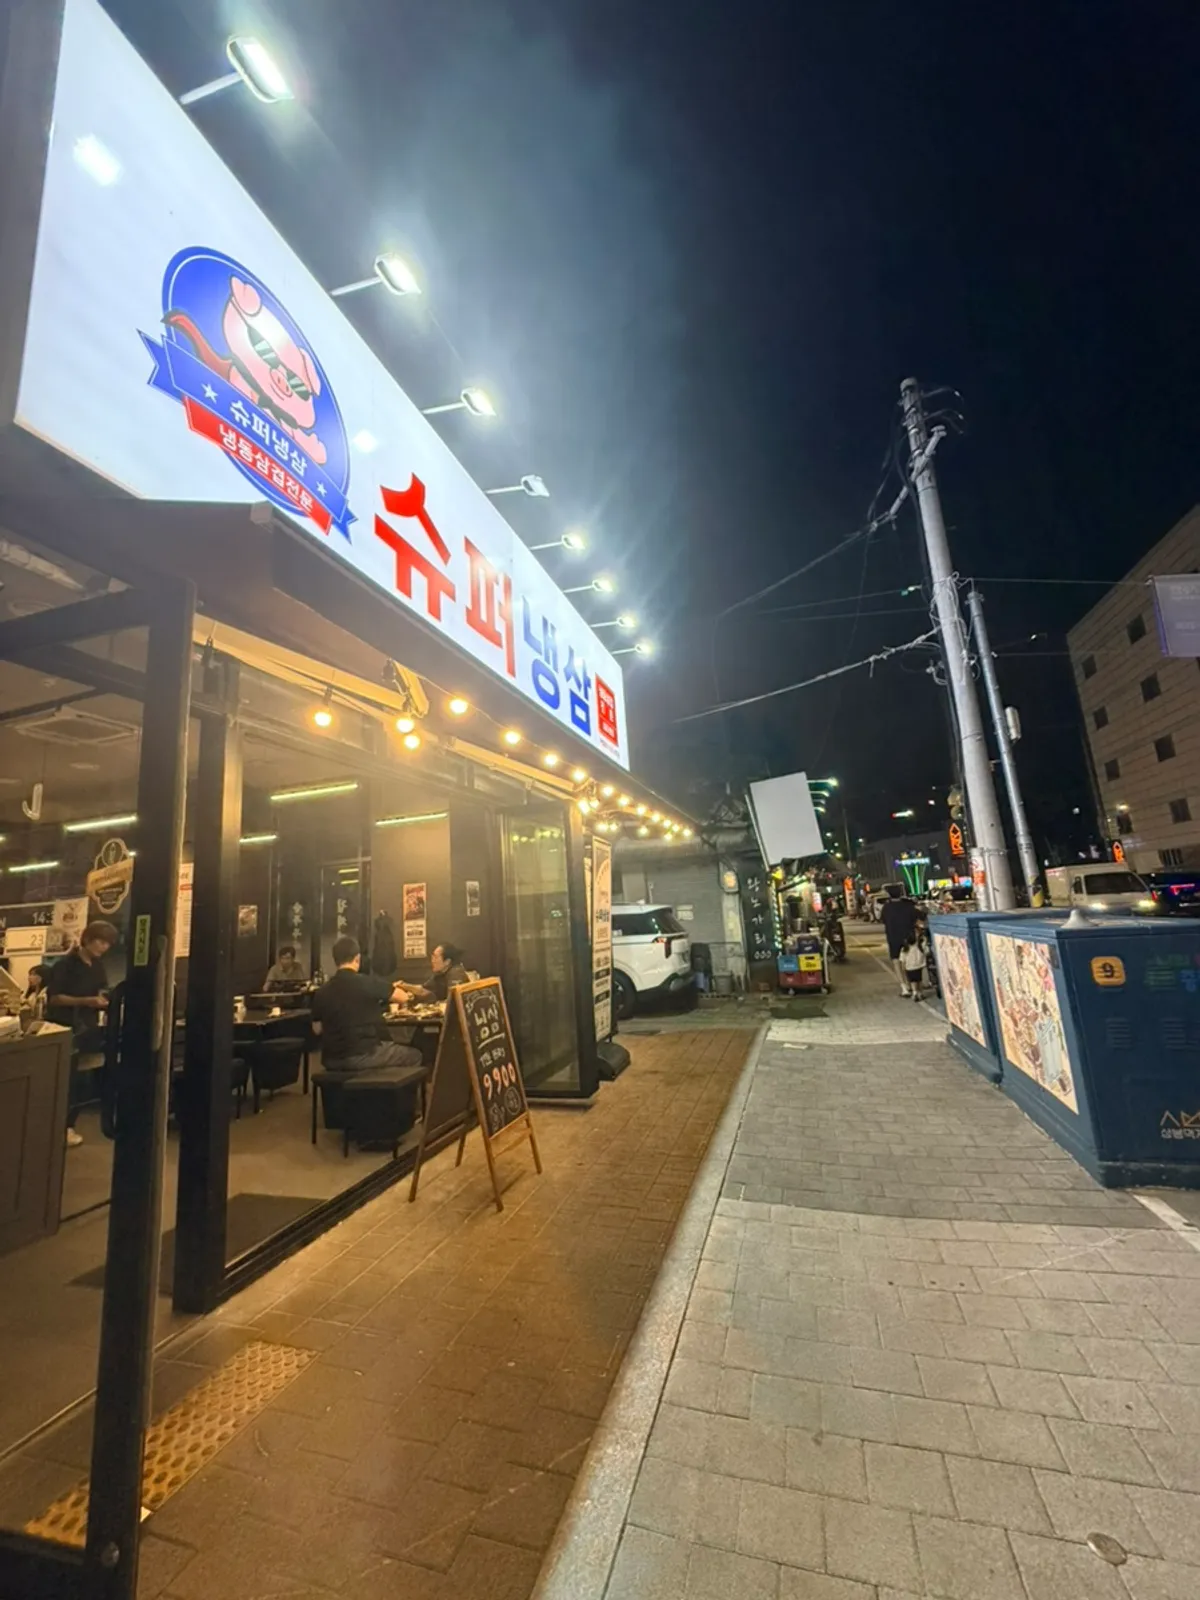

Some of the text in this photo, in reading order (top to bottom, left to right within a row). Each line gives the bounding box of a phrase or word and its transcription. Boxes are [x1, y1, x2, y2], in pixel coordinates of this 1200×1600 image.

[229, 400, 308, 478] 슈퍼냉삼
[218, 423, 313, 514] 냉동삼겹전문
[1101, 962, 1115, 978] 9
[474, 1003, 500, 1041] 냉삼
[483, 1061, 517, 1101] 9900
